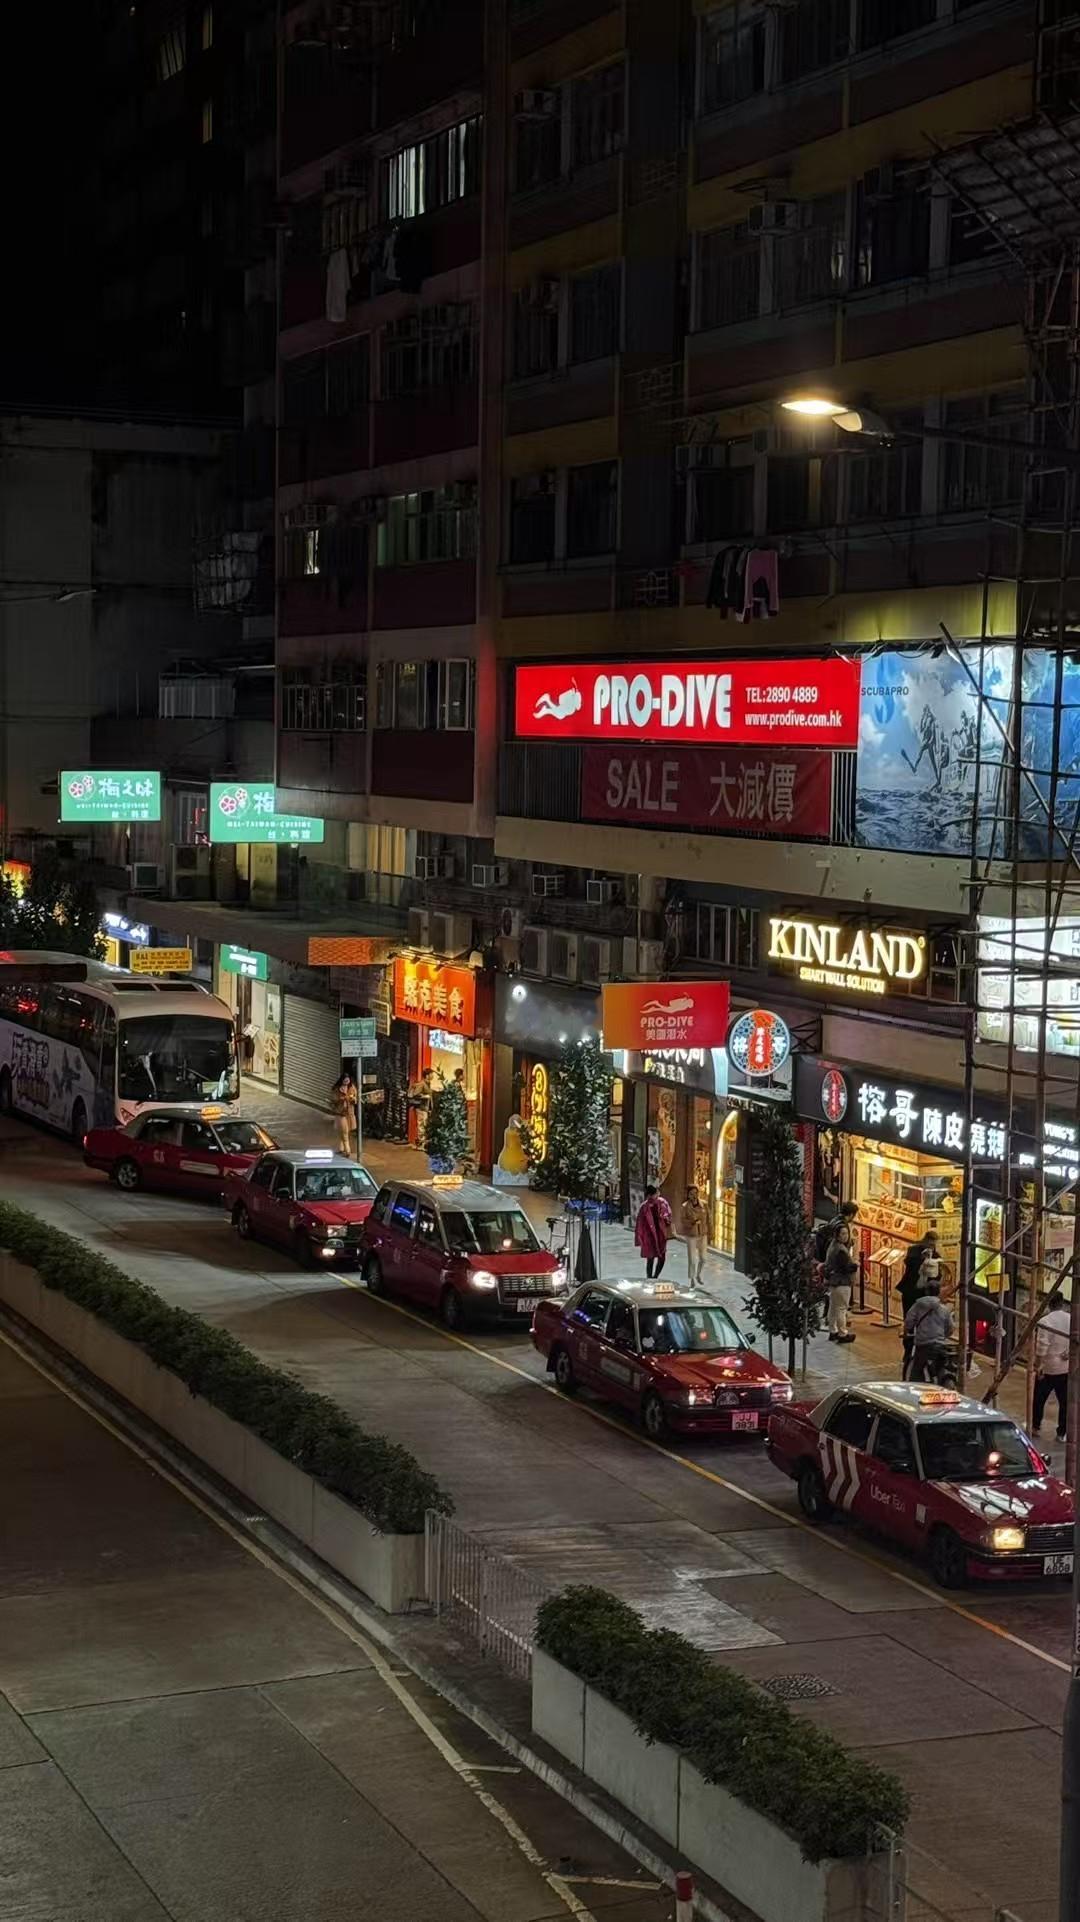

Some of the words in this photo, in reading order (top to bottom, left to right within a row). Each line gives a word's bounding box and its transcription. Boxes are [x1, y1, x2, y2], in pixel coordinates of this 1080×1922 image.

[745, 687, 790, 703] TEL:2890
[792, 686, 818, 703] 4889
[861, 686, 909, 696] SCUBAPRO
[593, 674, 732, 729] PRO-DIVE
[745, 710, 842, 728] www.prodive.com.hk
[98, 778, 154, 798] 梅之味
[607, 759, 679, 812] SALE
[710, 761, 797, 822] 大減價
[768, 918, 923, 980] KINLAND
[640, 1016, 694, 1028] PRO-DIVE
[870, 1483, 890, 1504] Uber
